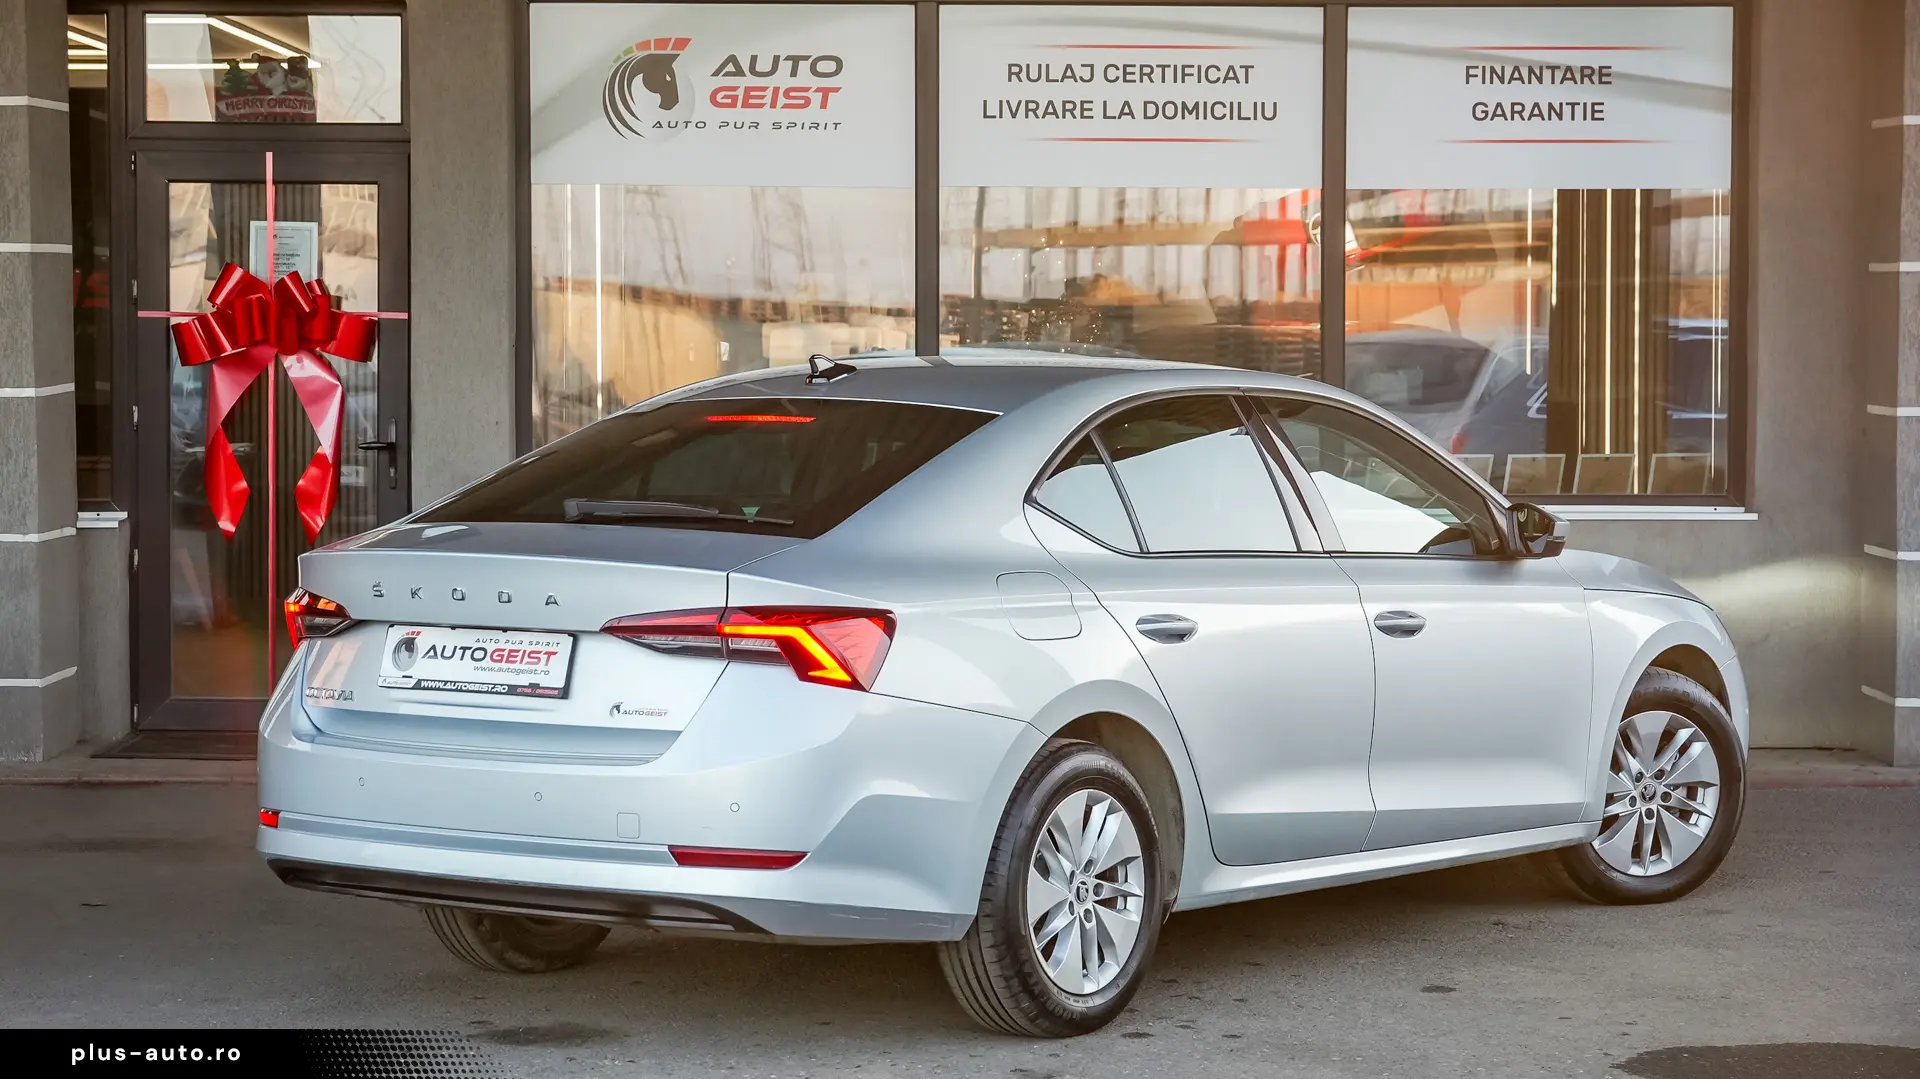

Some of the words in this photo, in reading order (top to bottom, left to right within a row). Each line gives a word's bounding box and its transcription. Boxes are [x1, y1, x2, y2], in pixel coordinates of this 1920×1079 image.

[709, 53, 844, 78] AUTO
[1007, 63, 1095, 83] RULAJ
[1103, 64, 1255, 84] CERTIFICAT
[1465, 65, 1613, 85] FINANTARE
[225, 97, 264, 112] MERRY
[709, 85, 843, 110] GEIST
[982, 99, 1095, 119] LIVRARE
[1102, 100, 1136, 120] LA
[1143, 101, 1278, 121] DOMICILIU
[1471, 102, 1605, 121] GARANTIE
[651, 120, 707, 129] AUTO
[718, 121, 760, 130] PUR
[772, 121, 843, 131] SPIRIT
[372, 580, 561, 606] ŠKODA
[474, 665, 550, 676] www.autogeist.ro
[420, 680, 508, 693] WWW.AUTOGEIST.RO
